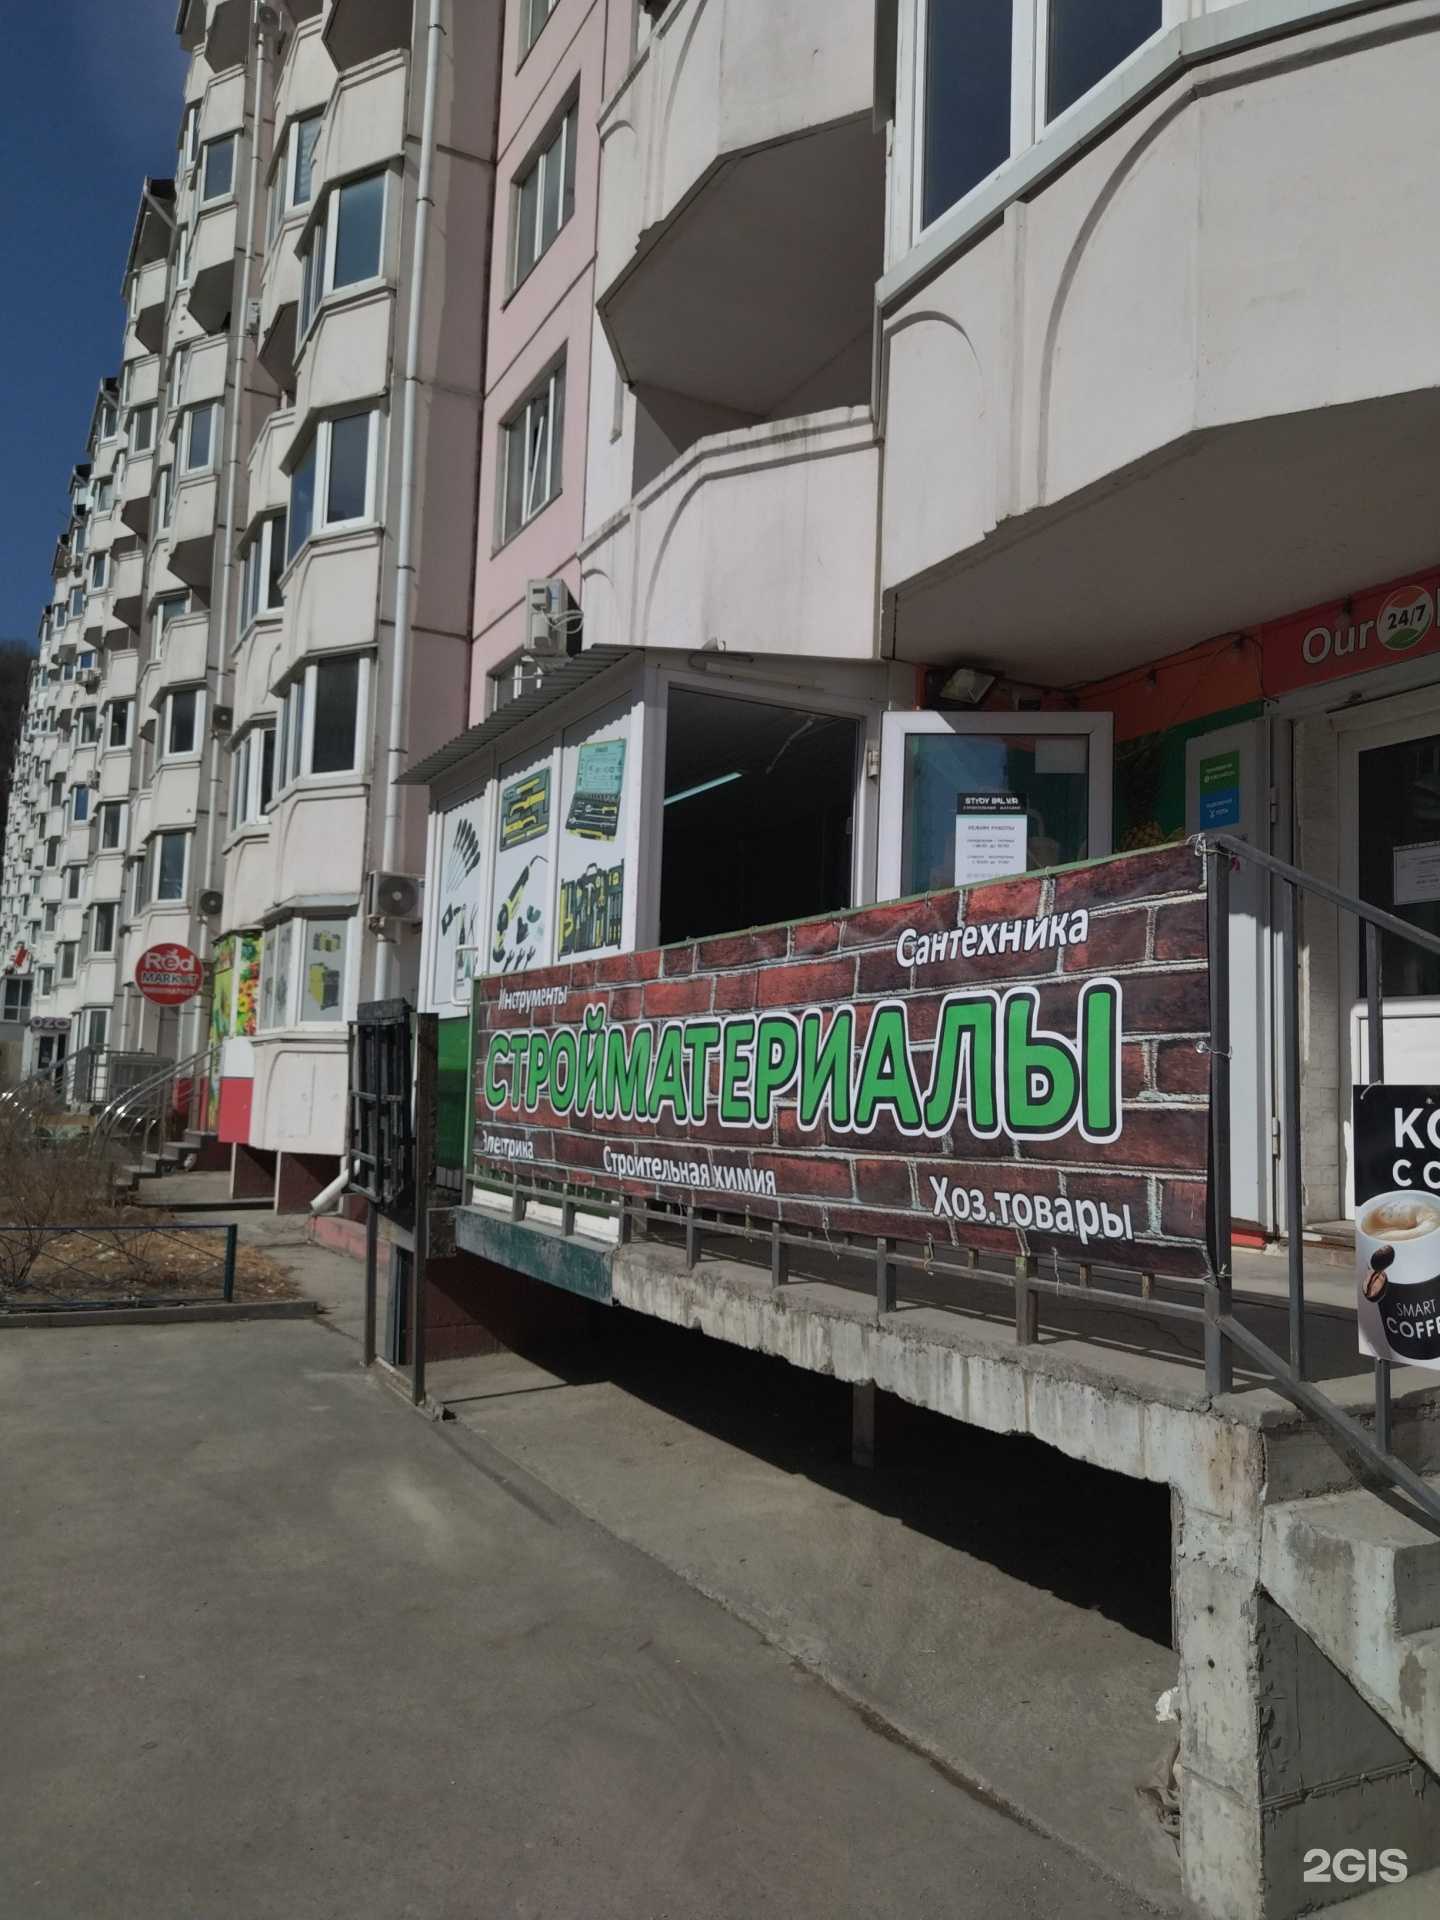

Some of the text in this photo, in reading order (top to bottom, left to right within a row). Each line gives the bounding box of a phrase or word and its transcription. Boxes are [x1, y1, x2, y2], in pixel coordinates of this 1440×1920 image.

[1387, 603, 1426, 630] 24/7
[1302, 621, 1375, 664] Our
[896, 908, 1089, 968] Сантехника
[145, 951, 194, 972] Red
[498, 986, 568, 1014] Инструменты
[484, 978, 1122, 1144] СТРОЙМАТЕРИАЛЫ
[482, 1130, 534, 1160] Электрика
[603, 1145, 777, 1195] Строительная химия
[929, 1175, 1134, 1245] Хоз.товары
[1396, 1299, 1436, 1317] SMART
